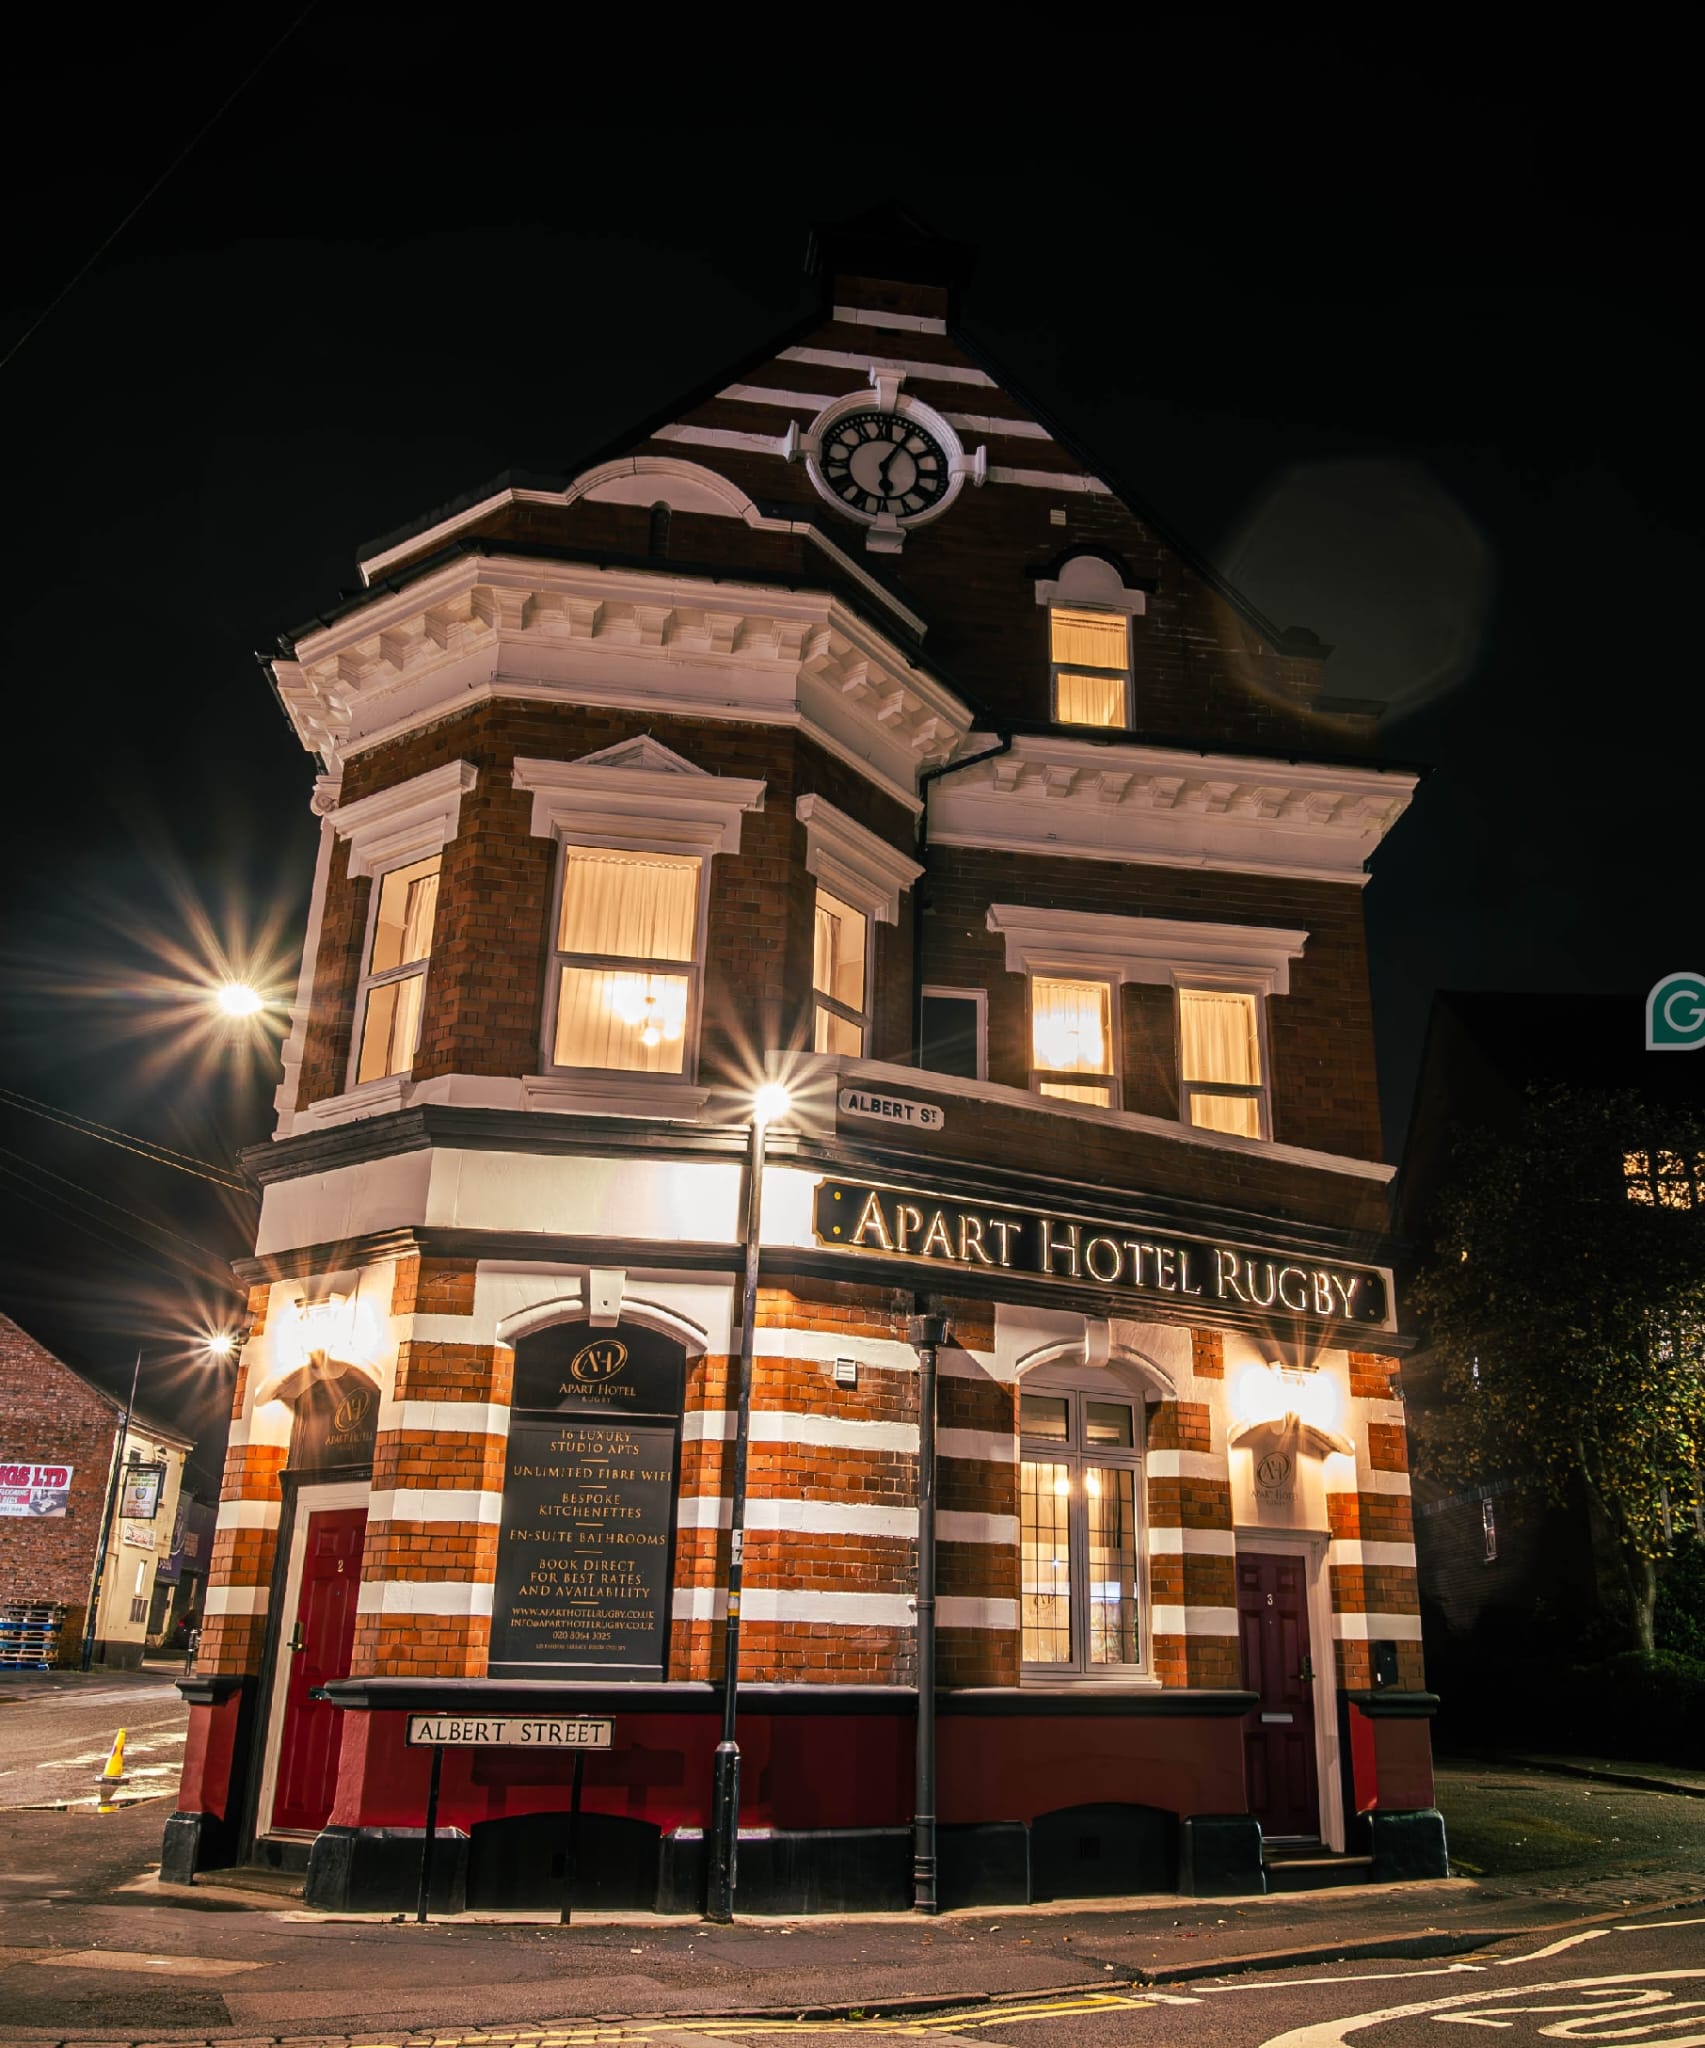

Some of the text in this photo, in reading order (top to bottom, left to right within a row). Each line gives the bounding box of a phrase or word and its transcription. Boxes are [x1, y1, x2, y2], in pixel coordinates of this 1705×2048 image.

[848, 1094, 914, 1120] ALBERT
[849, 1191, 1359, 1319] APART HOTEL RUGBY
[559, 1383, 637, 1397] APART HOTEL
[580, 1431, 631, 1443] LUXURY
[551, 1441, 640, 1456] STUDIO APTS
[32, 1467, 68, 1487] LTD
[513, 1465, 672, 1482] UNLIMITED FIBRE WIFI
[562, 1492, 621, 1505] BESPOKE
[539, 1505, 641, 1519] KITCHENETTES
[509, 1529, 666, 1545] EN-SUITE BATHROOMS
[337, 1559, 344, 1573] 2
[539, 1559, 635, 1572] BOOK DIRECT
[530, 1571, 641, 1585] FOR BEST RATES
[519, 1585, 650, 1599] AND AVAILABILITY
[1266, 1593, 1274, 1606] 3
[417, 1721, 604, 1743] ALBERT STREET
